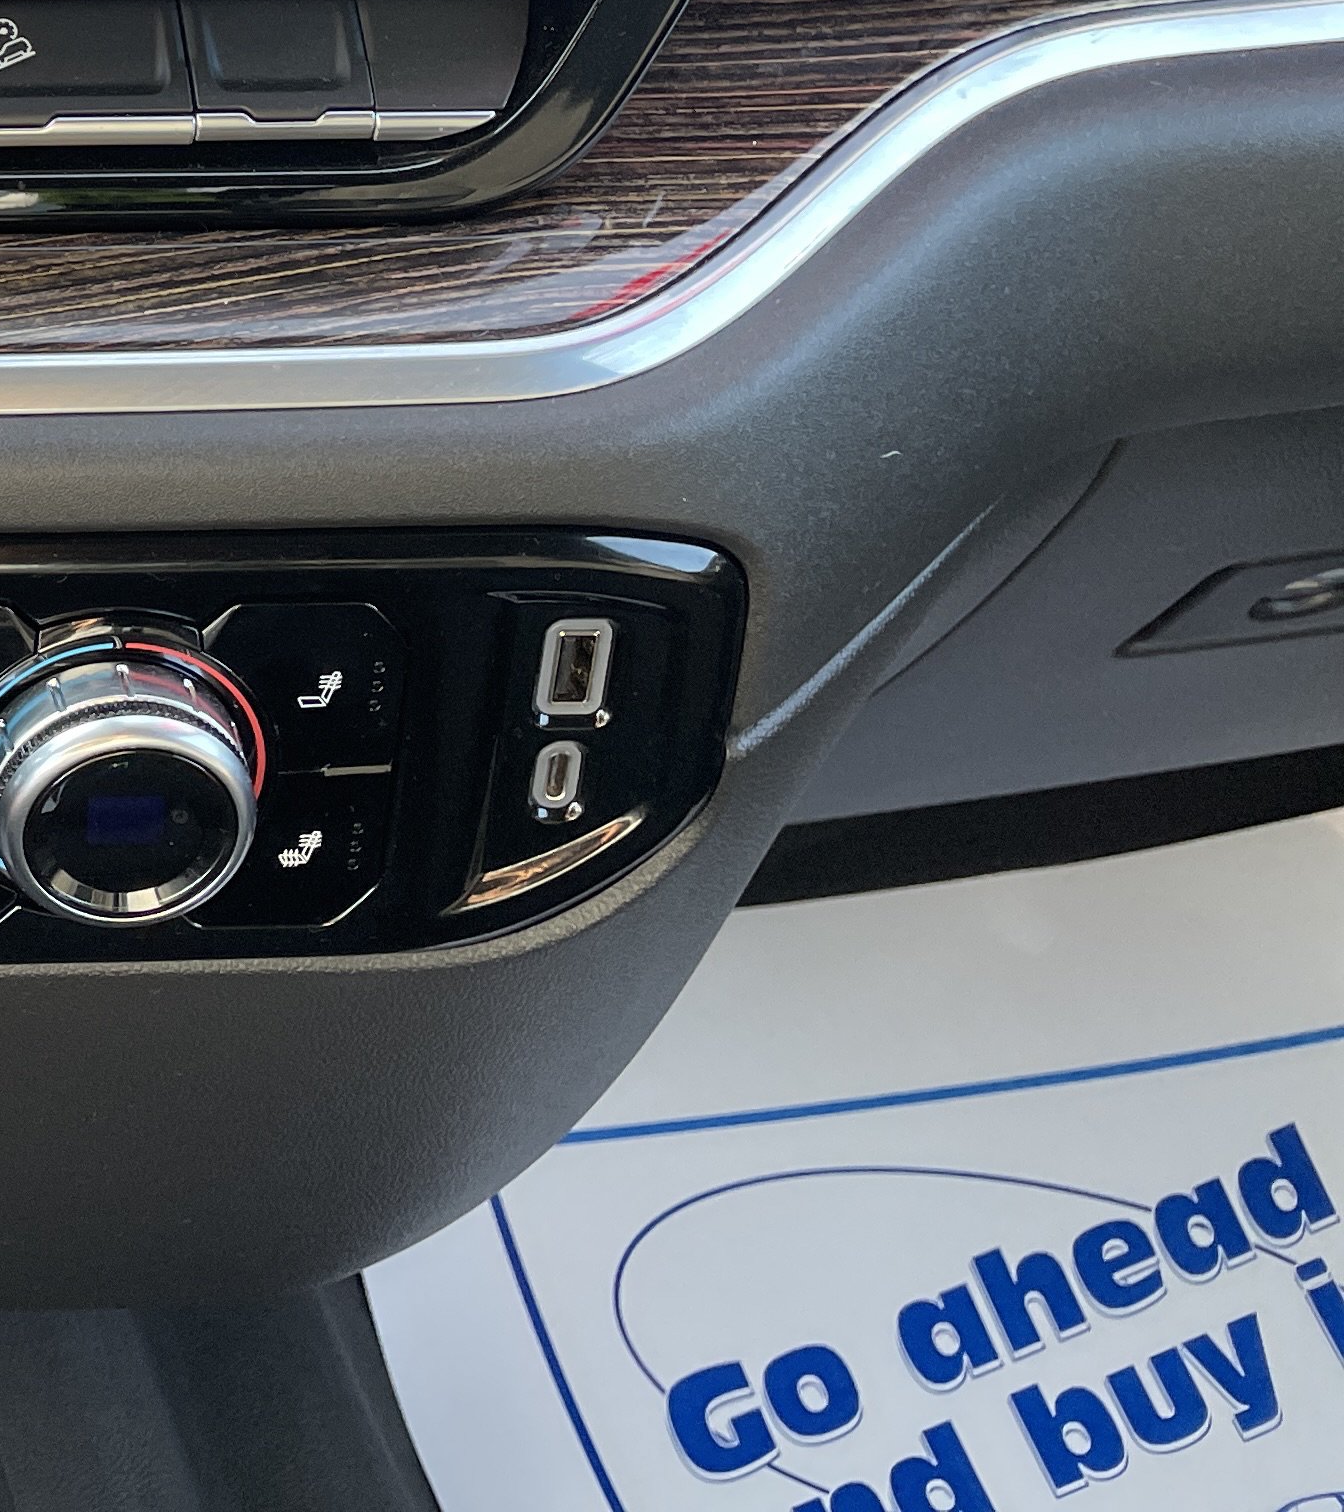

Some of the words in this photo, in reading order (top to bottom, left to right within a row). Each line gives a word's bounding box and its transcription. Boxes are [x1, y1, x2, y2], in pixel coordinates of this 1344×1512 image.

[668, 1343, 864, 1476] Go
[897, 1122, 1339, 1390] ahead
[1008, 1311, 1282, 1497] buy
